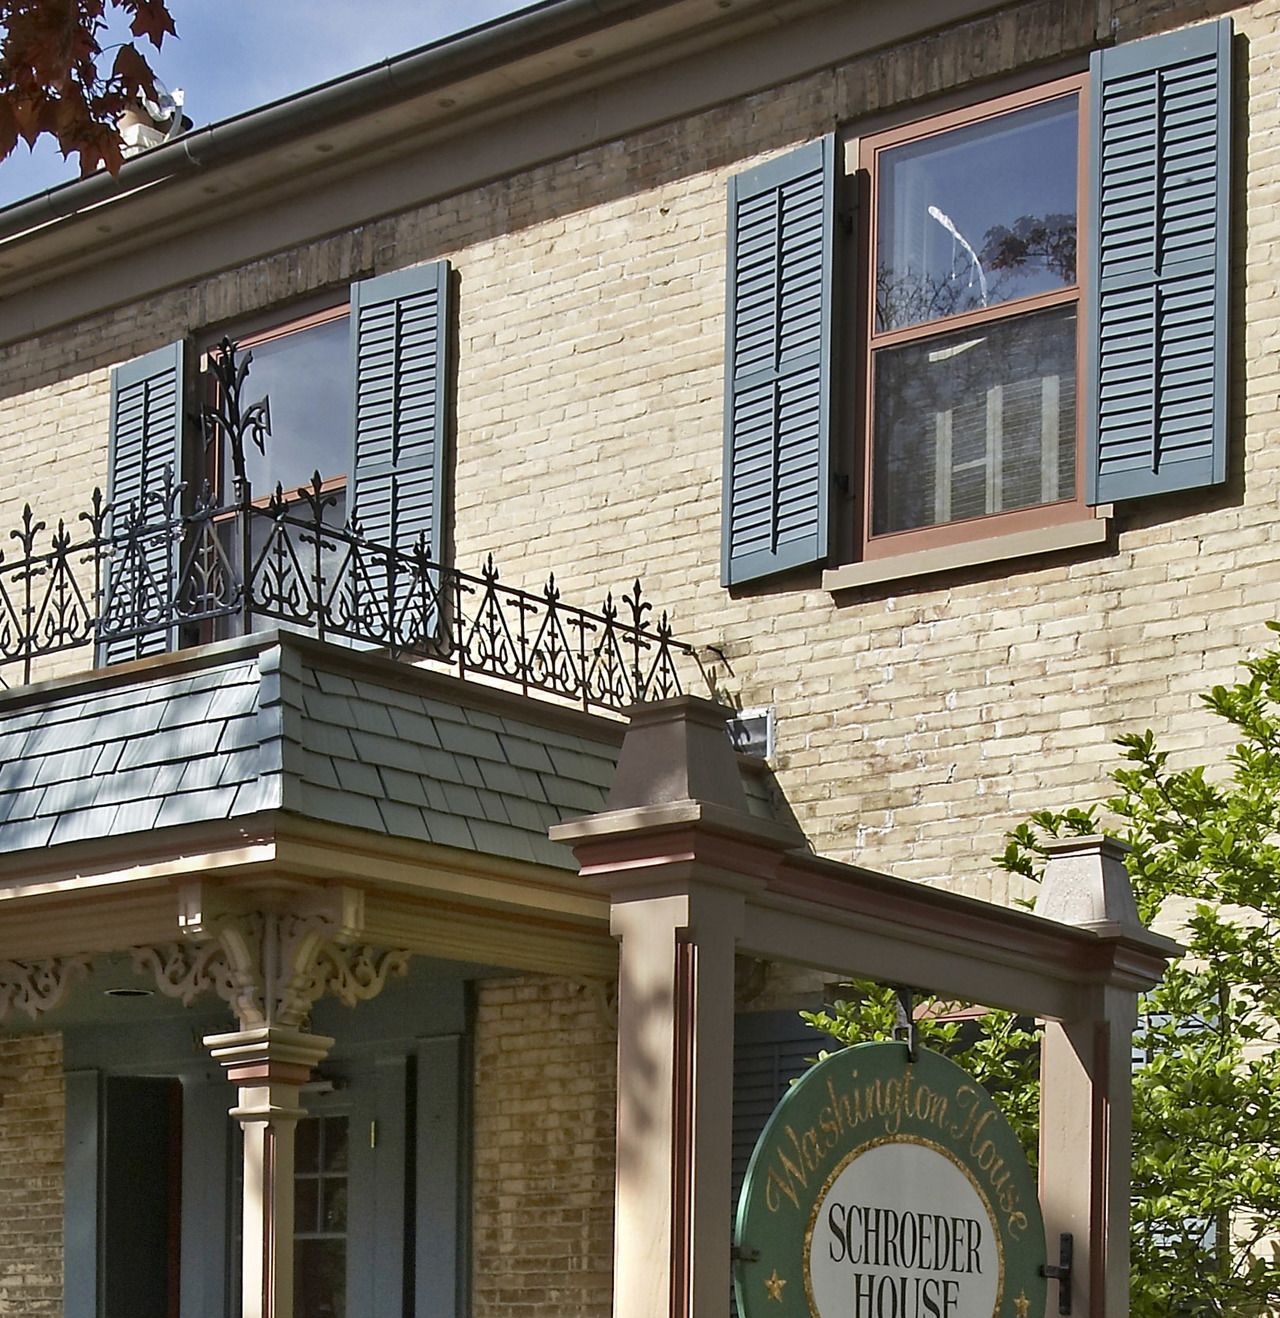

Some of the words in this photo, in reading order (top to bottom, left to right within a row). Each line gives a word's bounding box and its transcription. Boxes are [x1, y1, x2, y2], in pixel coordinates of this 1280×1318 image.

[765, 1069, 950, 1213] Washington
[949, 1085, 1028, 1240] House
[828, 1202, 983, 1275] SCHROEDER
